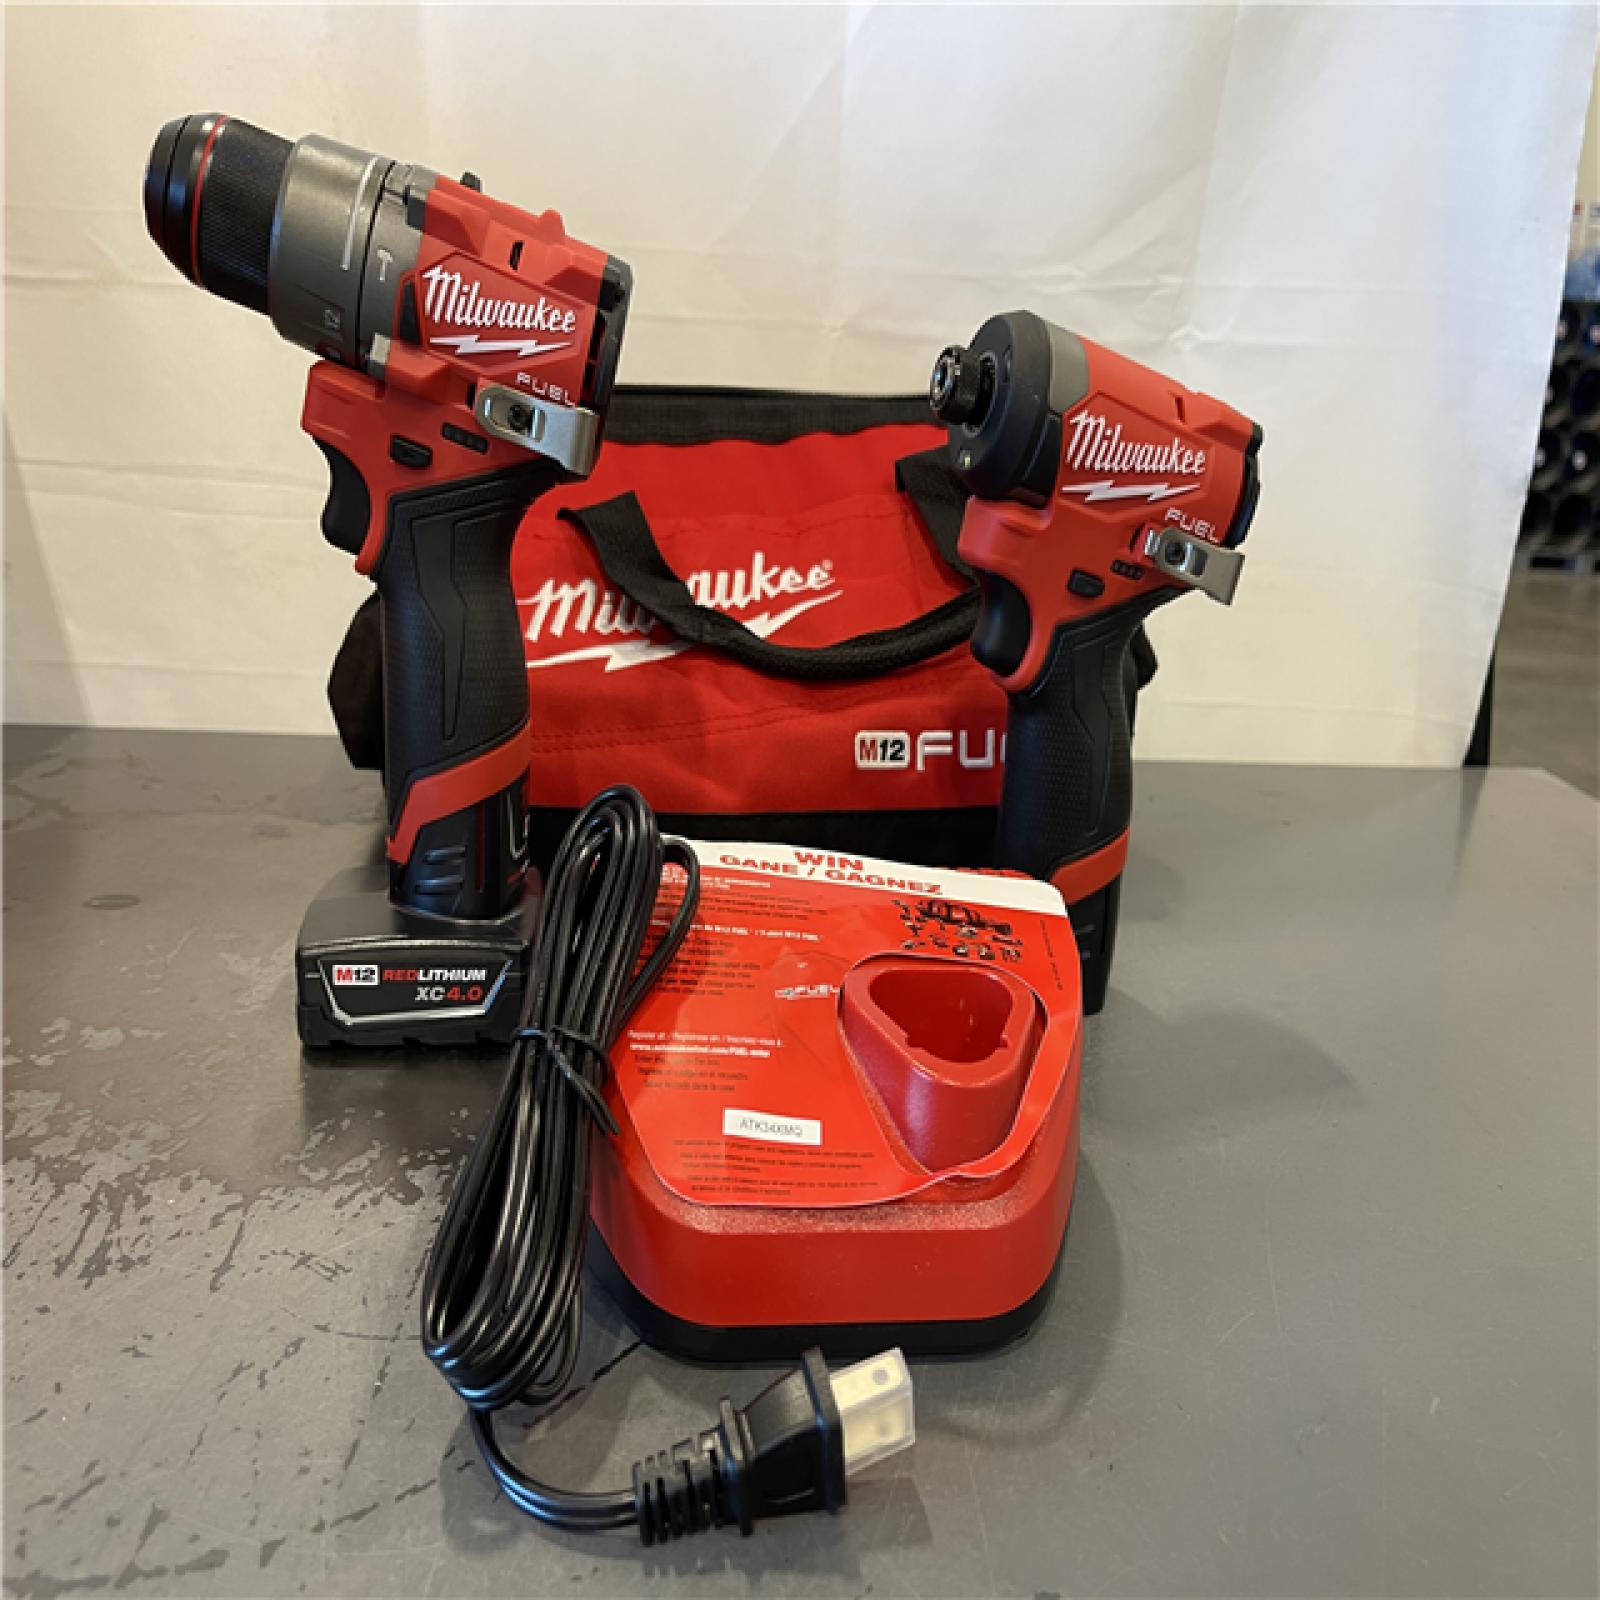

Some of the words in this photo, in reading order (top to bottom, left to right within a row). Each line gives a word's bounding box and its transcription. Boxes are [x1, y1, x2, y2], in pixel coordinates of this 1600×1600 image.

[422, 265, 576, 333] Milwaukee
[516, 372, 576, 407] FUEL
[1065, 409, 1206, 476] Milwaukee
[1165, 507, 1220, 543] FUEL
[858, 735, 907, 763] M12
[719, 854, 799, 874] GANE
[795, 851, 864, 871] WIN
[335, 966, 377, 983] M12
